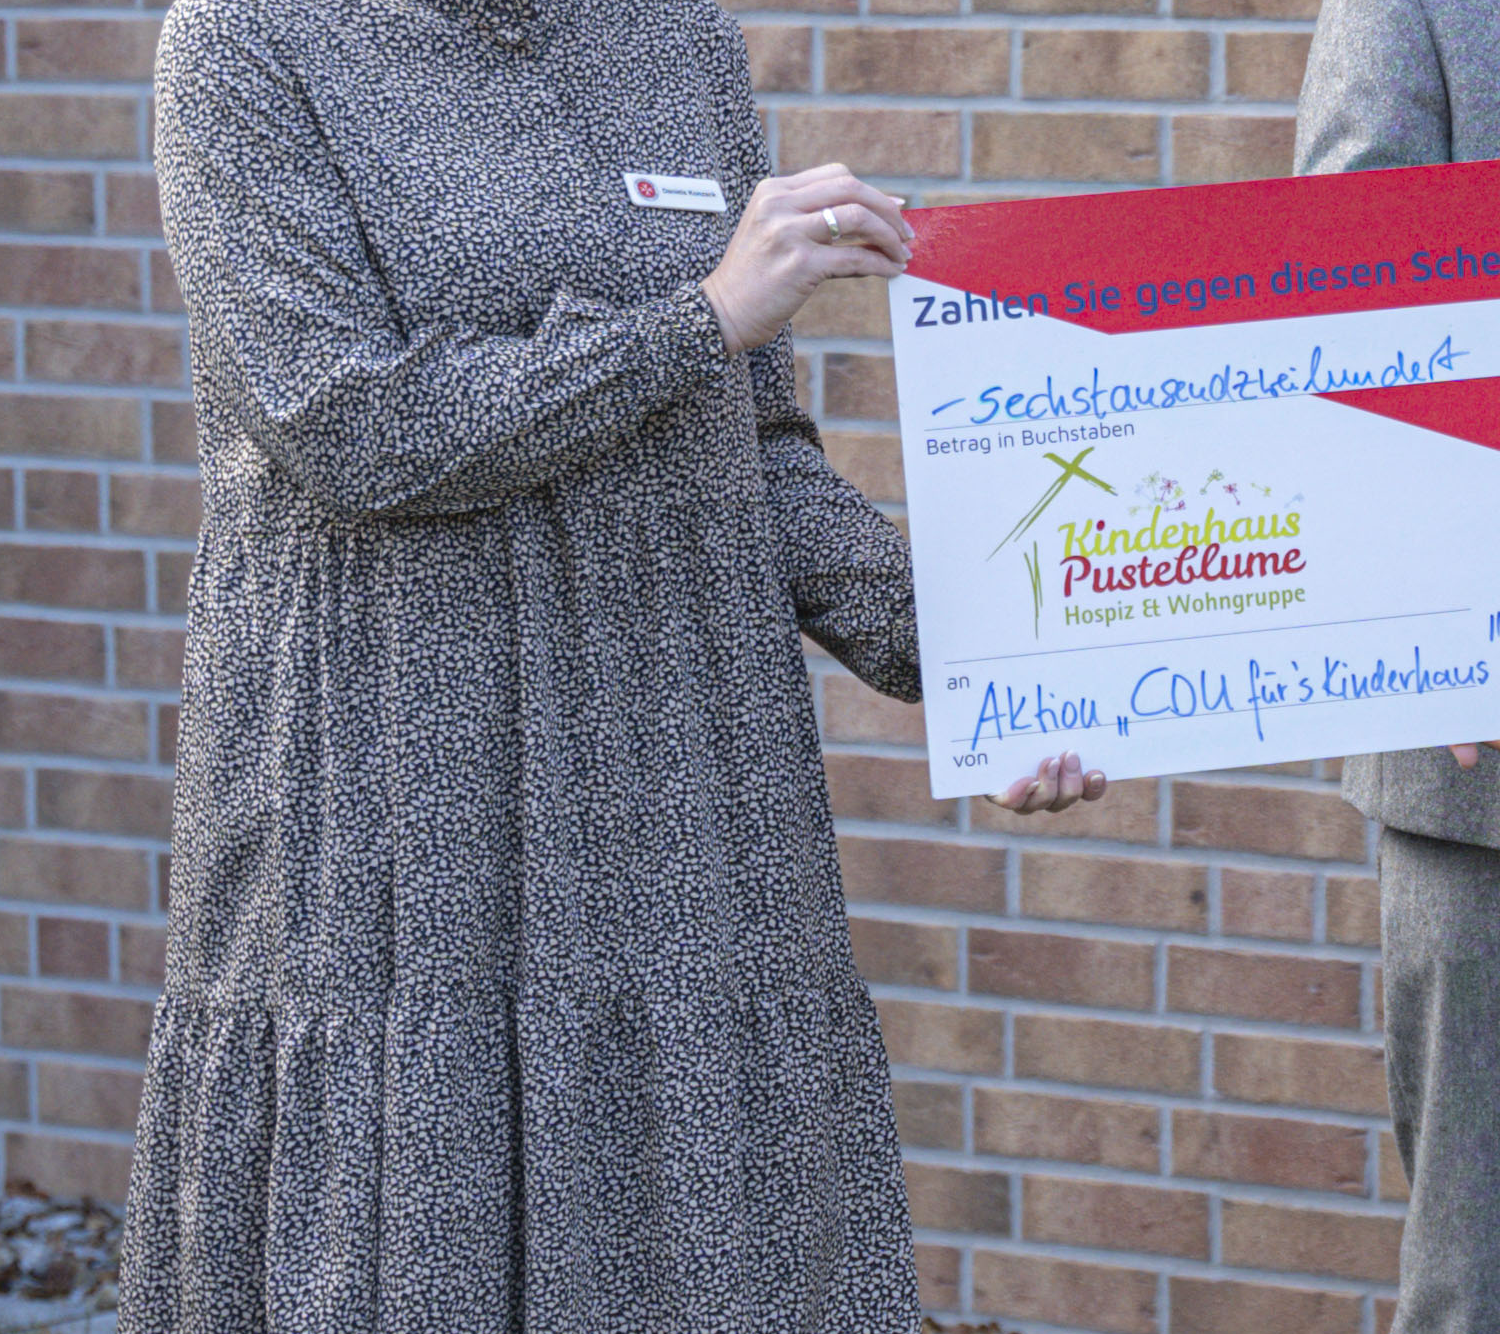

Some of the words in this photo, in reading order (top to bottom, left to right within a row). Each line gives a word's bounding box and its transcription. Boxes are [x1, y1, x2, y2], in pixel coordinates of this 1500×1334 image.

[913, 289, 1049, 328] Zahlen
[1063, 279, 1122, 314] Sie
[1136, 273, 1256, 316] gegen
[1270, 262, 1397, 295] diesen
[926, 432, 992, 455] Betrag
[998, 431, 1015, 449] in
[1022, 421, 1135, 447] Buchstaben
[1057, 505, 1301, 561] Kinderhaus
[1059, 543, 1307, 598] Pusteblume
[1064, 600, 1135, 628] Hospiz
[1142, 598, 1161, 618] &
[1167, 587, 1307, 615] Wohngruppe
[947, 675, 970, 690] an
[953, 752, 989, 768] von
